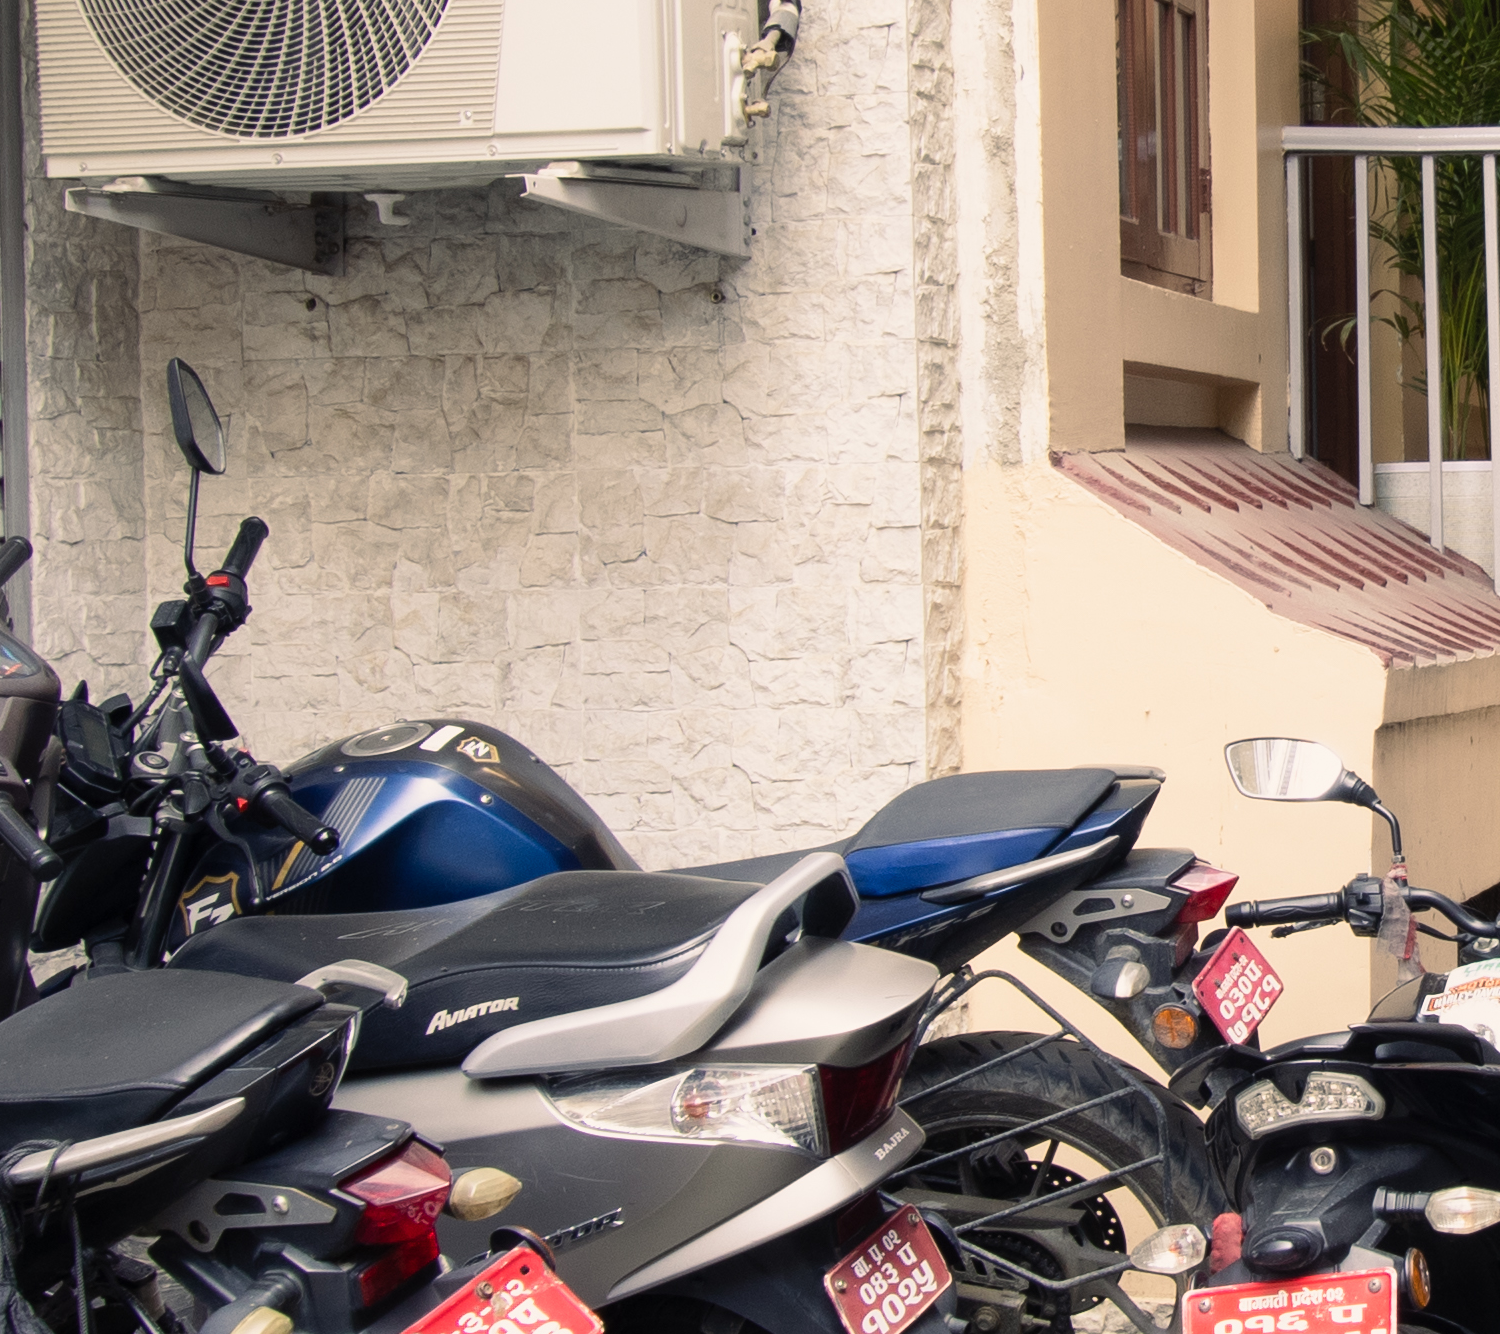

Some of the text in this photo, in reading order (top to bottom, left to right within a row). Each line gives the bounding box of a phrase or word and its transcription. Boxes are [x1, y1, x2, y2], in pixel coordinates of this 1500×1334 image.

[874, 1126, 910, 1161] BAJRA
[881, 1229, 901, 1252] ०२
[861, 1259, 938, 1334] १०२५
[1238, 1289, 1289, 1312] बागमती
